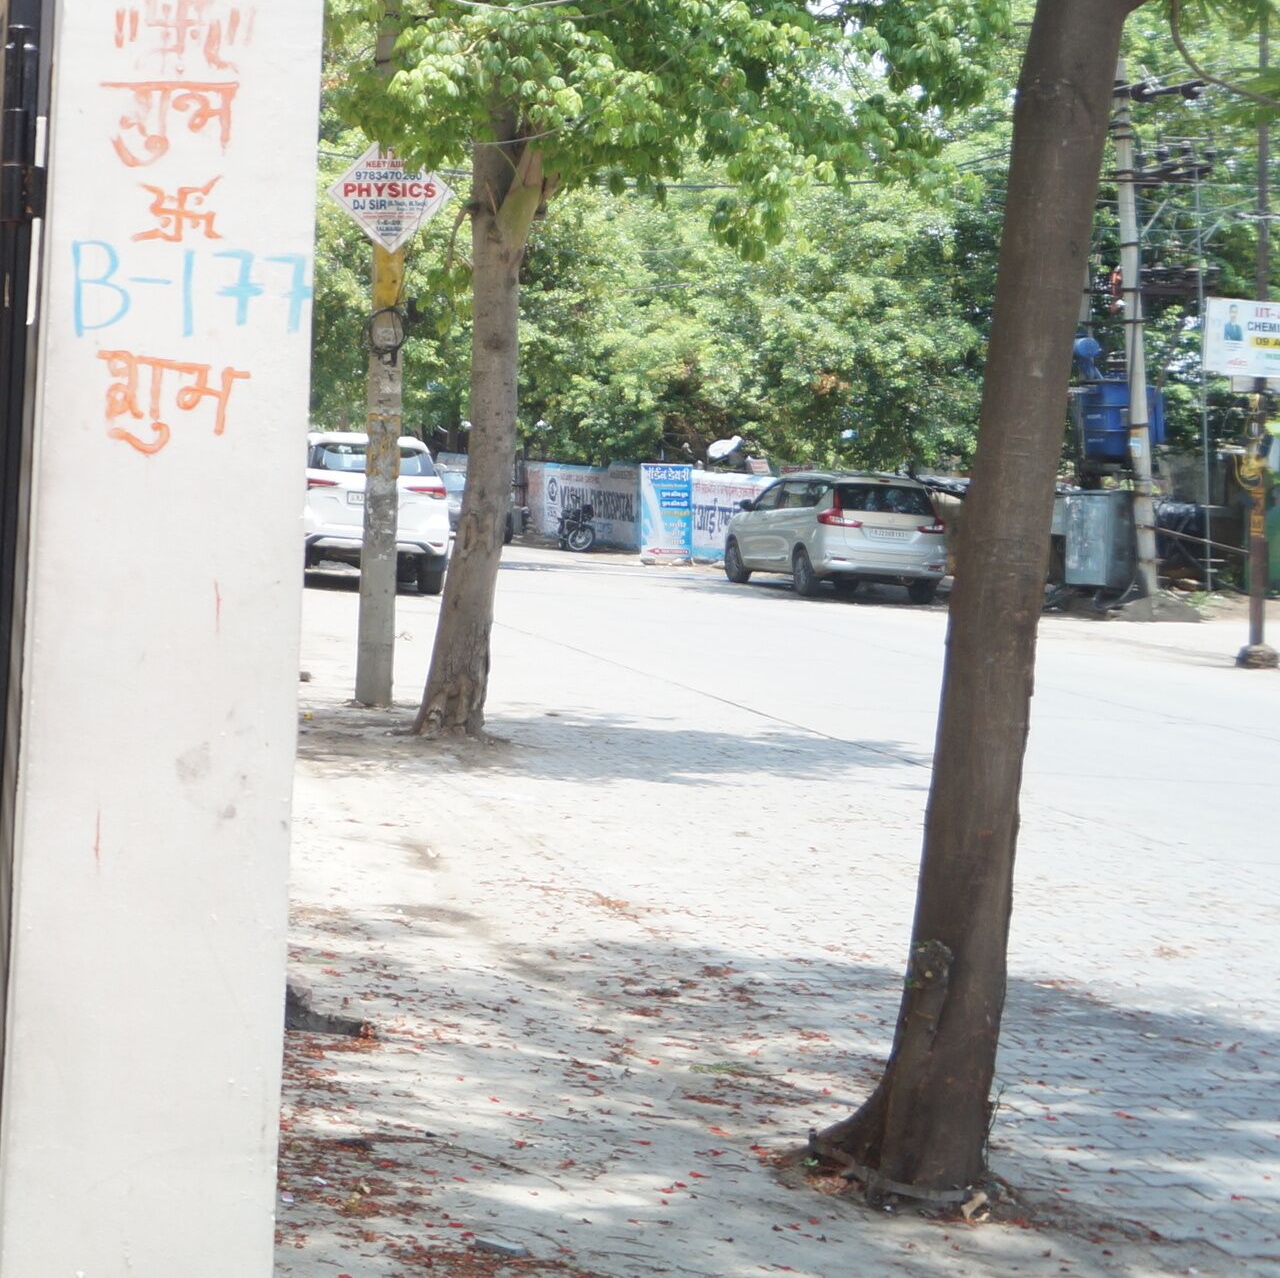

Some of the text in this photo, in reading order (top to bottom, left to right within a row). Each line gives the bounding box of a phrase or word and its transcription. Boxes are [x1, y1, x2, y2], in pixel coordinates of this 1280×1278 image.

[343, 182, 437, 198] PHYSICS
[353, 199, 366, 210] DJ
[369, 199, 387, 210] SIR
[72, 240, 313, 338] B-177
[1255, 307, 1280, 319] IIT-
